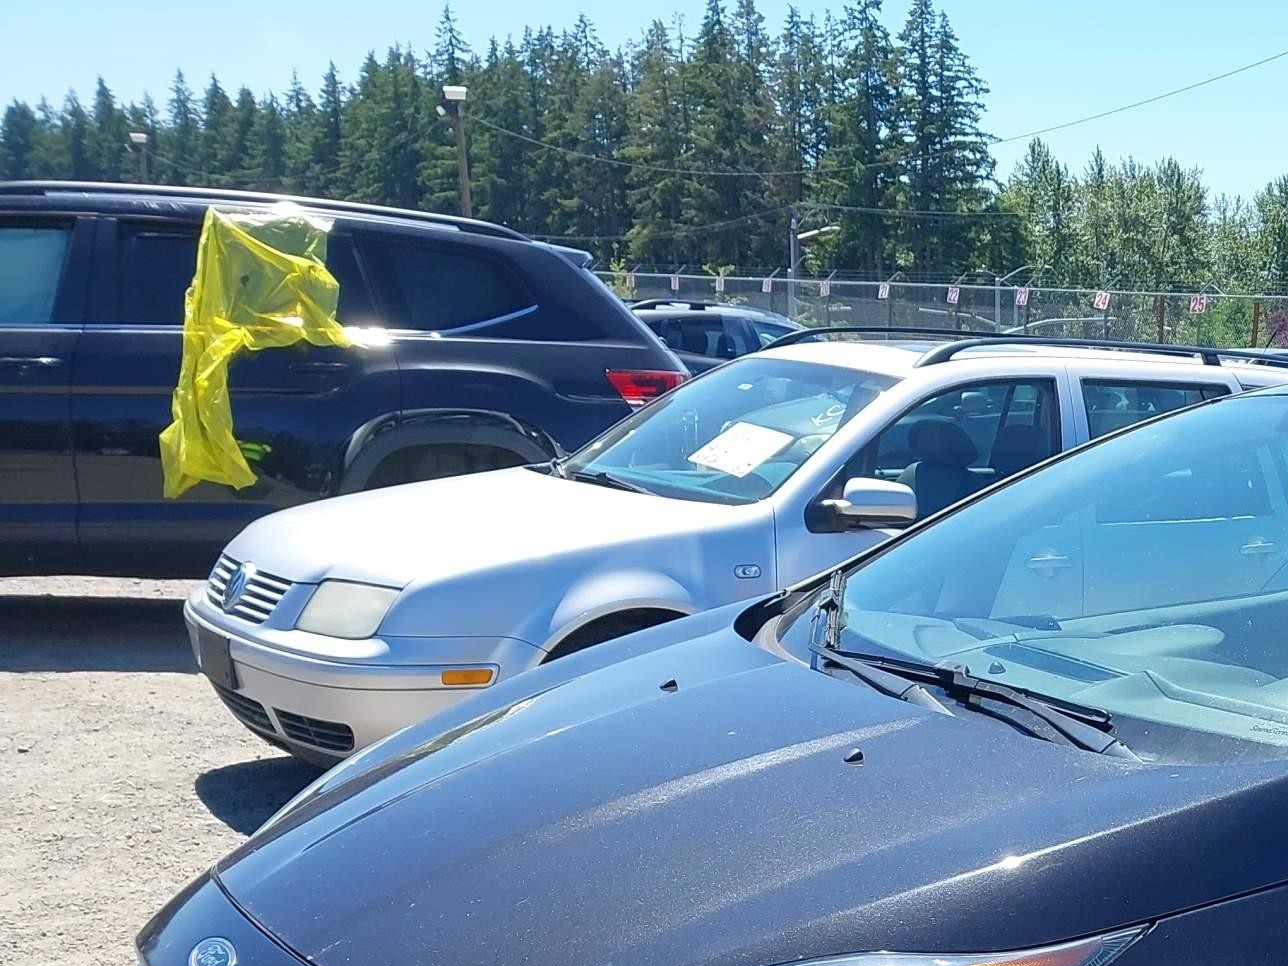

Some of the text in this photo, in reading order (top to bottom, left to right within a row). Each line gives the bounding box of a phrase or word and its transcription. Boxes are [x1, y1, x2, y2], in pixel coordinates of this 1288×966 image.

[949, 289, 958, 302] 22
[1017, 290, 1027, 304] 23
[1095, 293, 1108, 308] 24
[1191, 297, 1205, 312] 25
